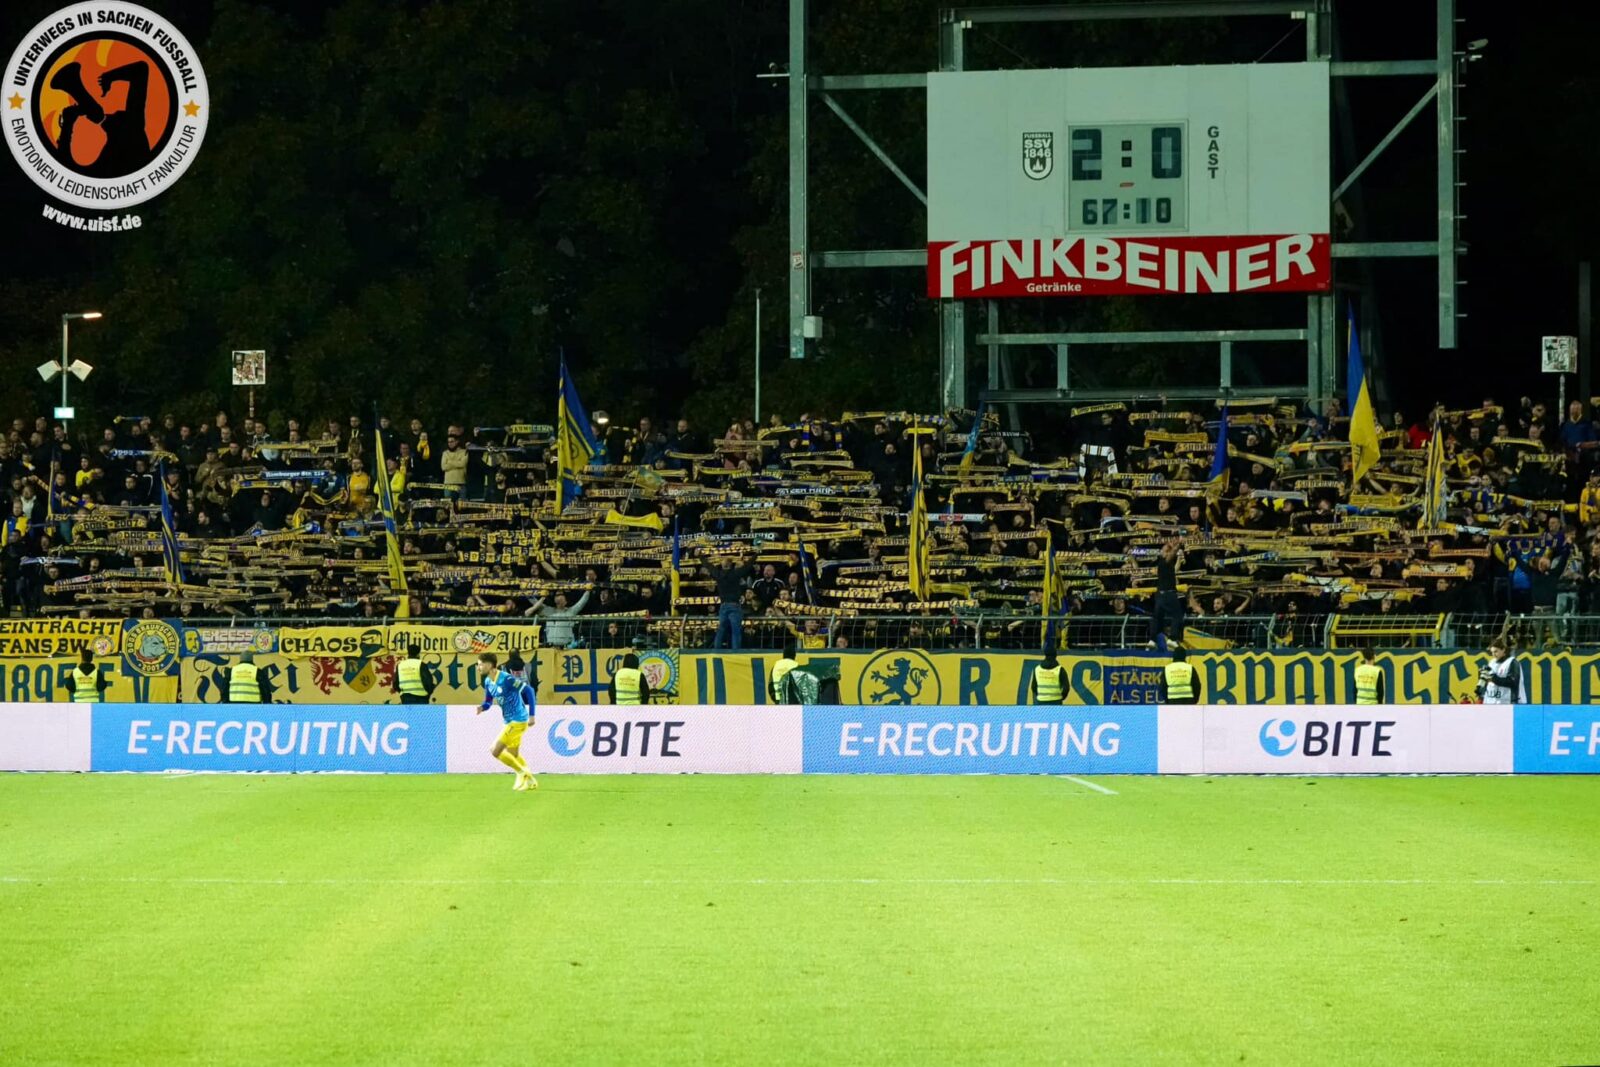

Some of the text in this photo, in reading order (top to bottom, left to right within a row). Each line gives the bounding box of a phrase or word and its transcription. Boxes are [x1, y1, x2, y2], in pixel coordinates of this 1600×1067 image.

[1024, 139, 1051, 148] SSV
[1206, 125, 1220, 179] GAST
[1024, 148, 1052, 158] 1846
[939, 234, 1316, 297] FINKBEINER
[1026, 282, 1082, 293] Getränke
[0, 621, 120, 635] EINTRACHT
[0, 638, 90, 654] FANS BW
[281, 636, 358, 653] CHAOS
[387, 631, 539, 652] Müden Aller
[1110, 668, 1162, 685] STÄRK
[1110, 689, 1141, 704] ALS
[127, 720, 409, 756] E-RECRUITING
[591, 721, 686, 757] BITE
[839, 721, 1121, 756] E-RECRUITING
[1302, 721, 1397, 757] BITE
